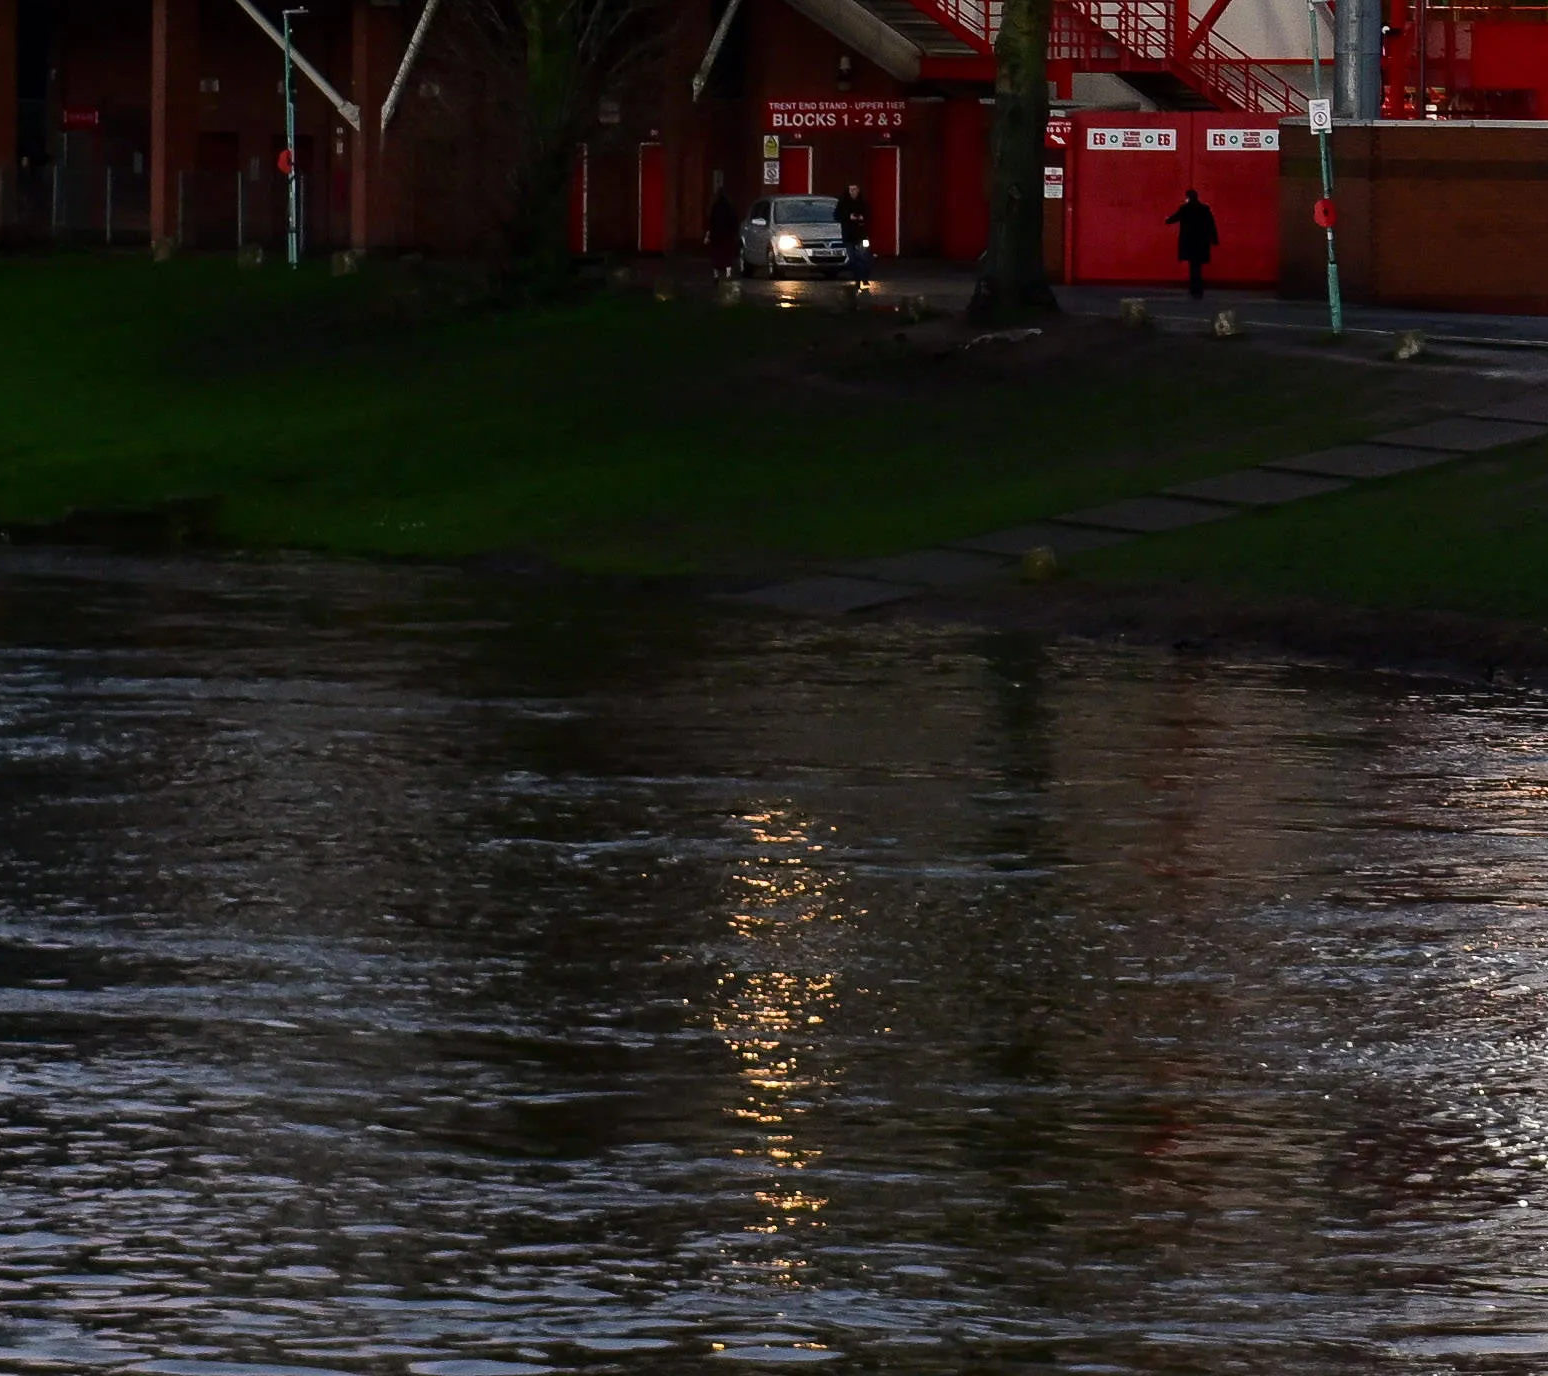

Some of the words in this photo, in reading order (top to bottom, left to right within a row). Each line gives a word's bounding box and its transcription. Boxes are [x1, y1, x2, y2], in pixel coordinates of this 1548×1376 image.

[768, 102, 796, 110] TRENT
[799, 102, 816, 110] END
[818, 102, 848, 110] STAND
[854, 102, 884, 110] UPPER
[772, 113, 837, 127] BLOCKS
[842, 113, 848, 127] 1
[864, 113, 873, 126] 2
[877, 113, 888, 127] &
[893, 113, 902, 126] 3
[1093, 133, 1106, 145] E6
[1158, 133, 1170, 146] E6
[1213, 133, 1225, 146] E6
